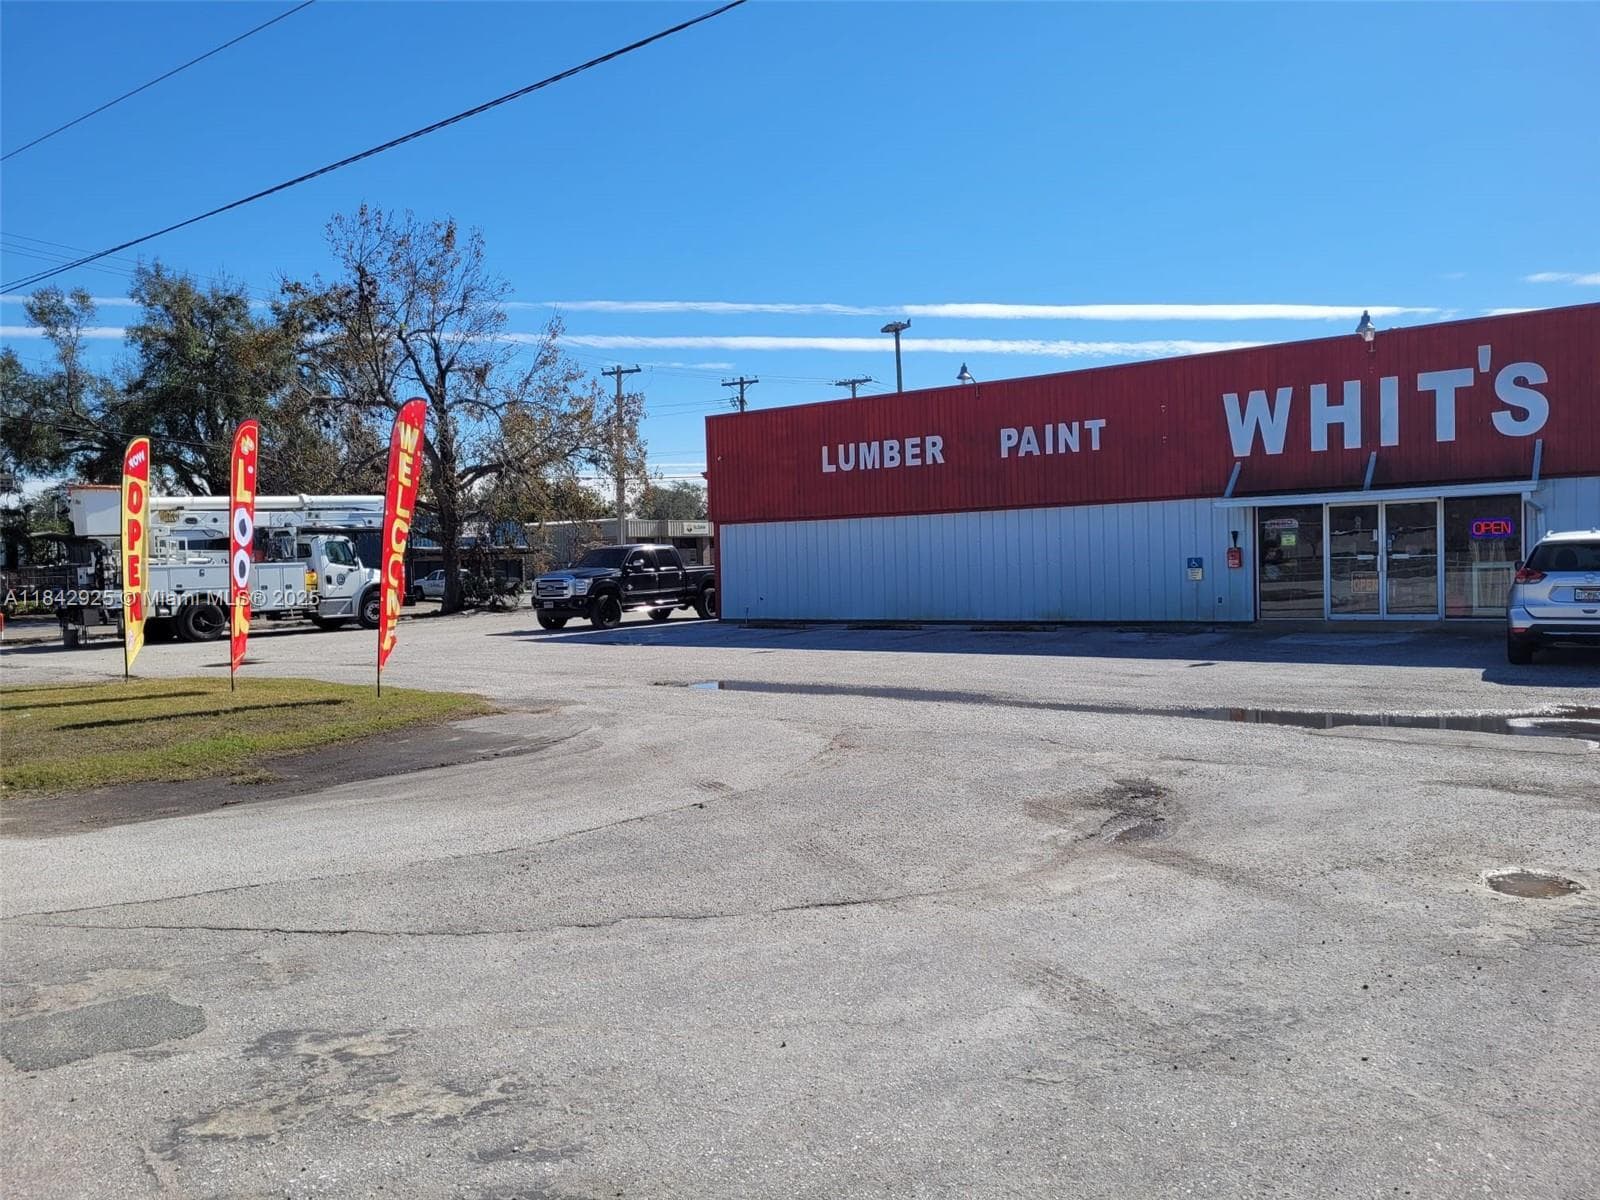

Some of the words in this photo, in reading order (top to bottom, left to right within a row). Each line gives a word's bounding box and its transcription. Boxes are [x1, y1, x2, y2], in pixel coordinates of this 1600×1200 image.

[822, 435, 945, 472] LUMBER
[1000, 419, 1106, 458] PAINT
[1223, 345, 1549, 457] WHIT'S
[127, 481, 143, 622] OPEN
[234, 459, 253, 637] LOOK
[1473, 521, 1511, 534] OPEN
